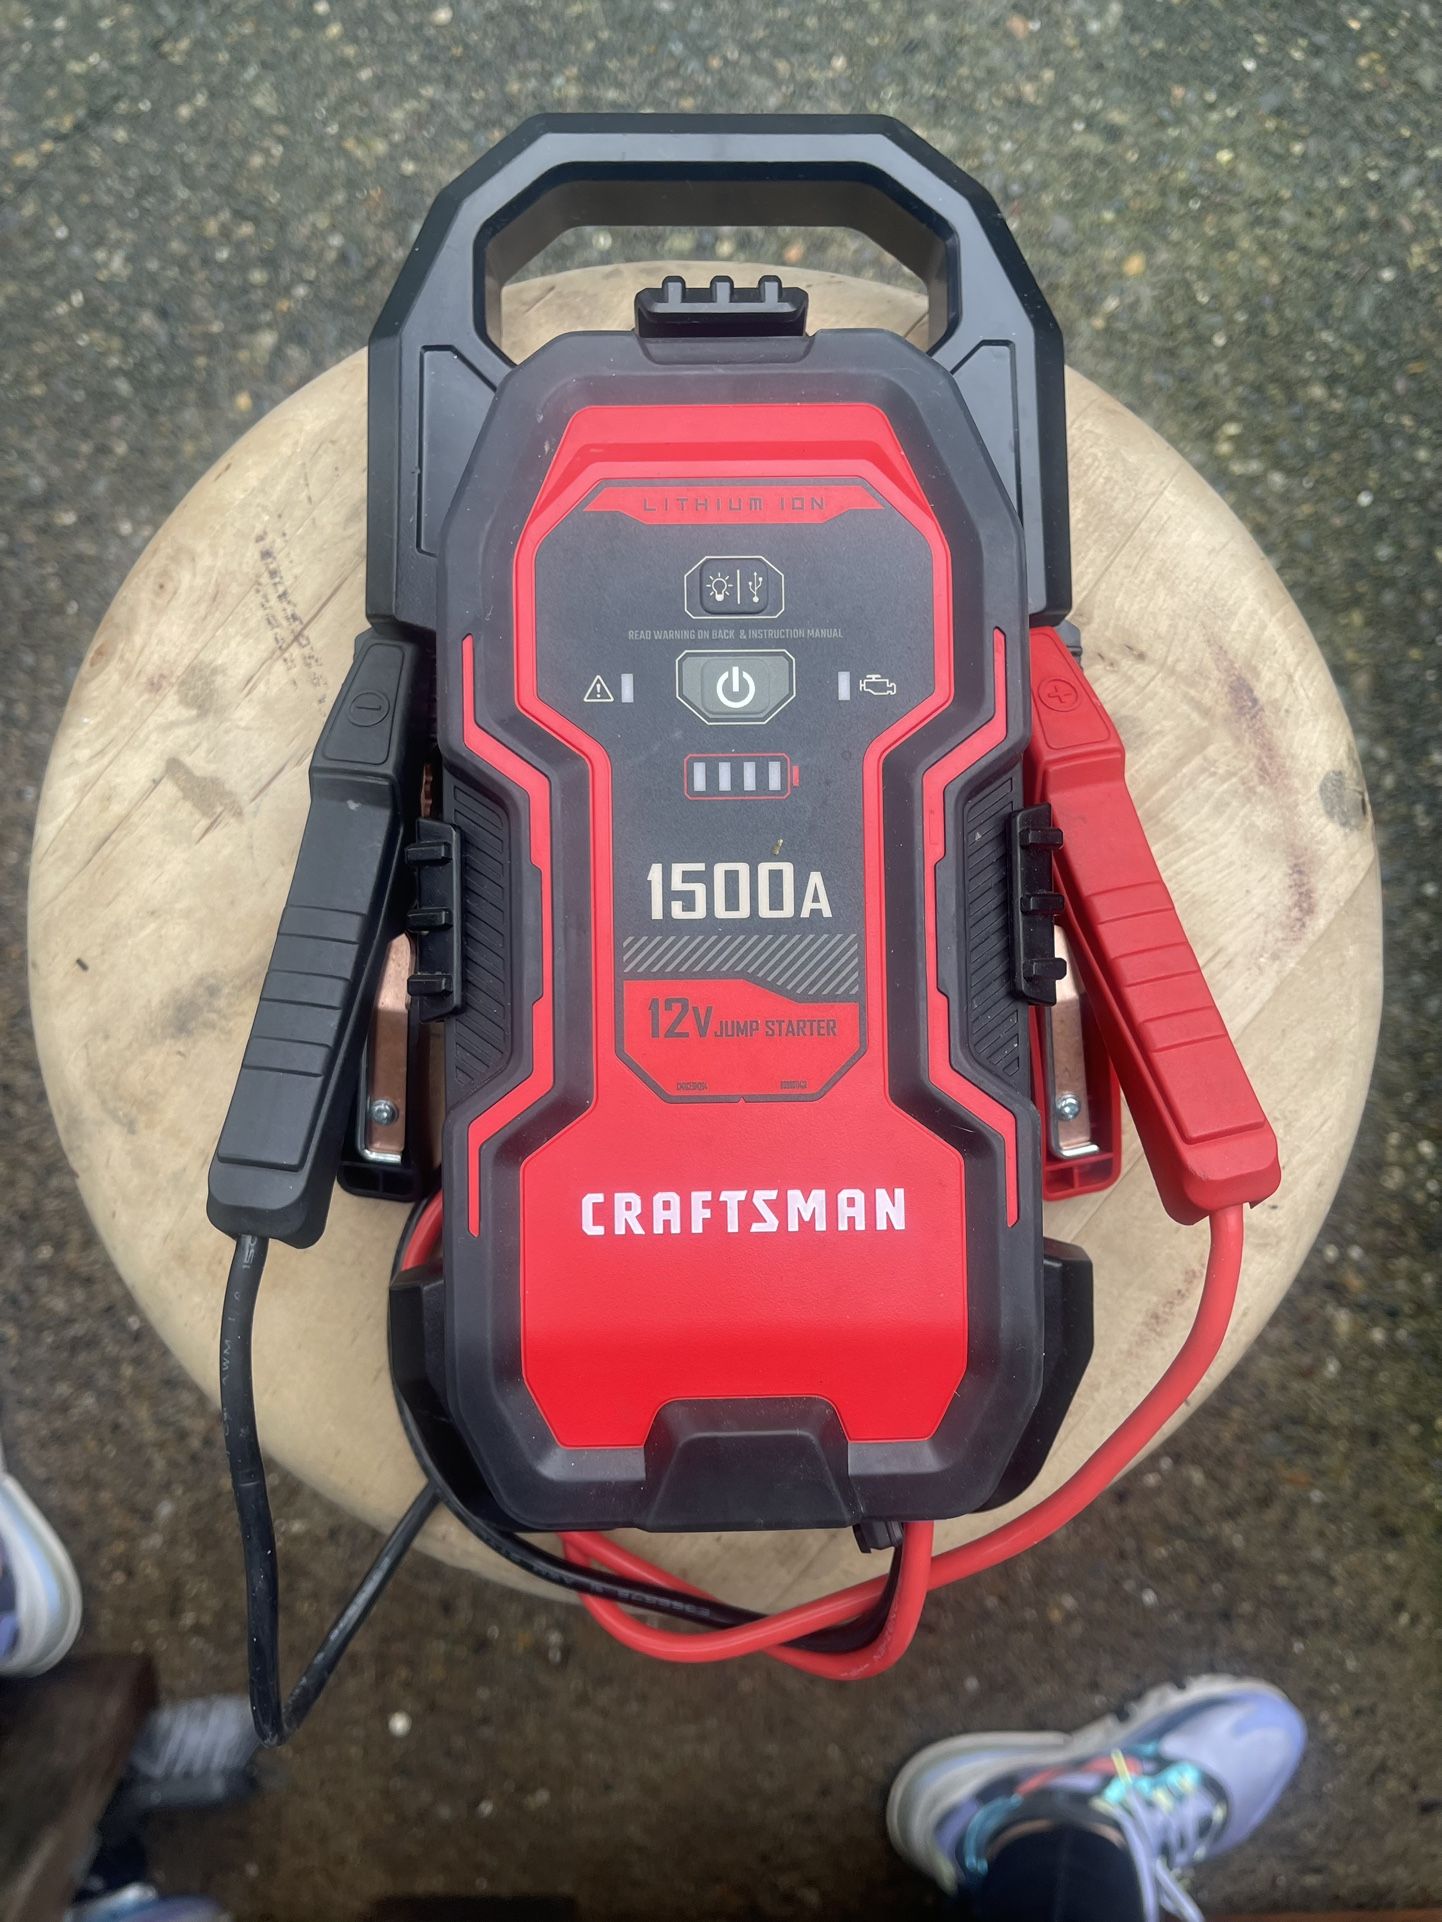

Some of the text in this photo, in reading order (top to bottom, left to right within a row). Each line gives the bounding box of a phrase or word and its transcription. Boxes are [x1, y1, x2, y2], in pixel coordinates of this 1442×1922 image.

[643, 496, 826, 512] LITHIUM ION
[628, 628, 843, 640] READ WARNING ON BACK & INSTRUCTION MANUAL
[647, 861, 833, 920] 1500A
[648, 997, 837, 1039] 12V JUMP STARTER
[581, 1187, 906, 1236] CRAFTSMAN
